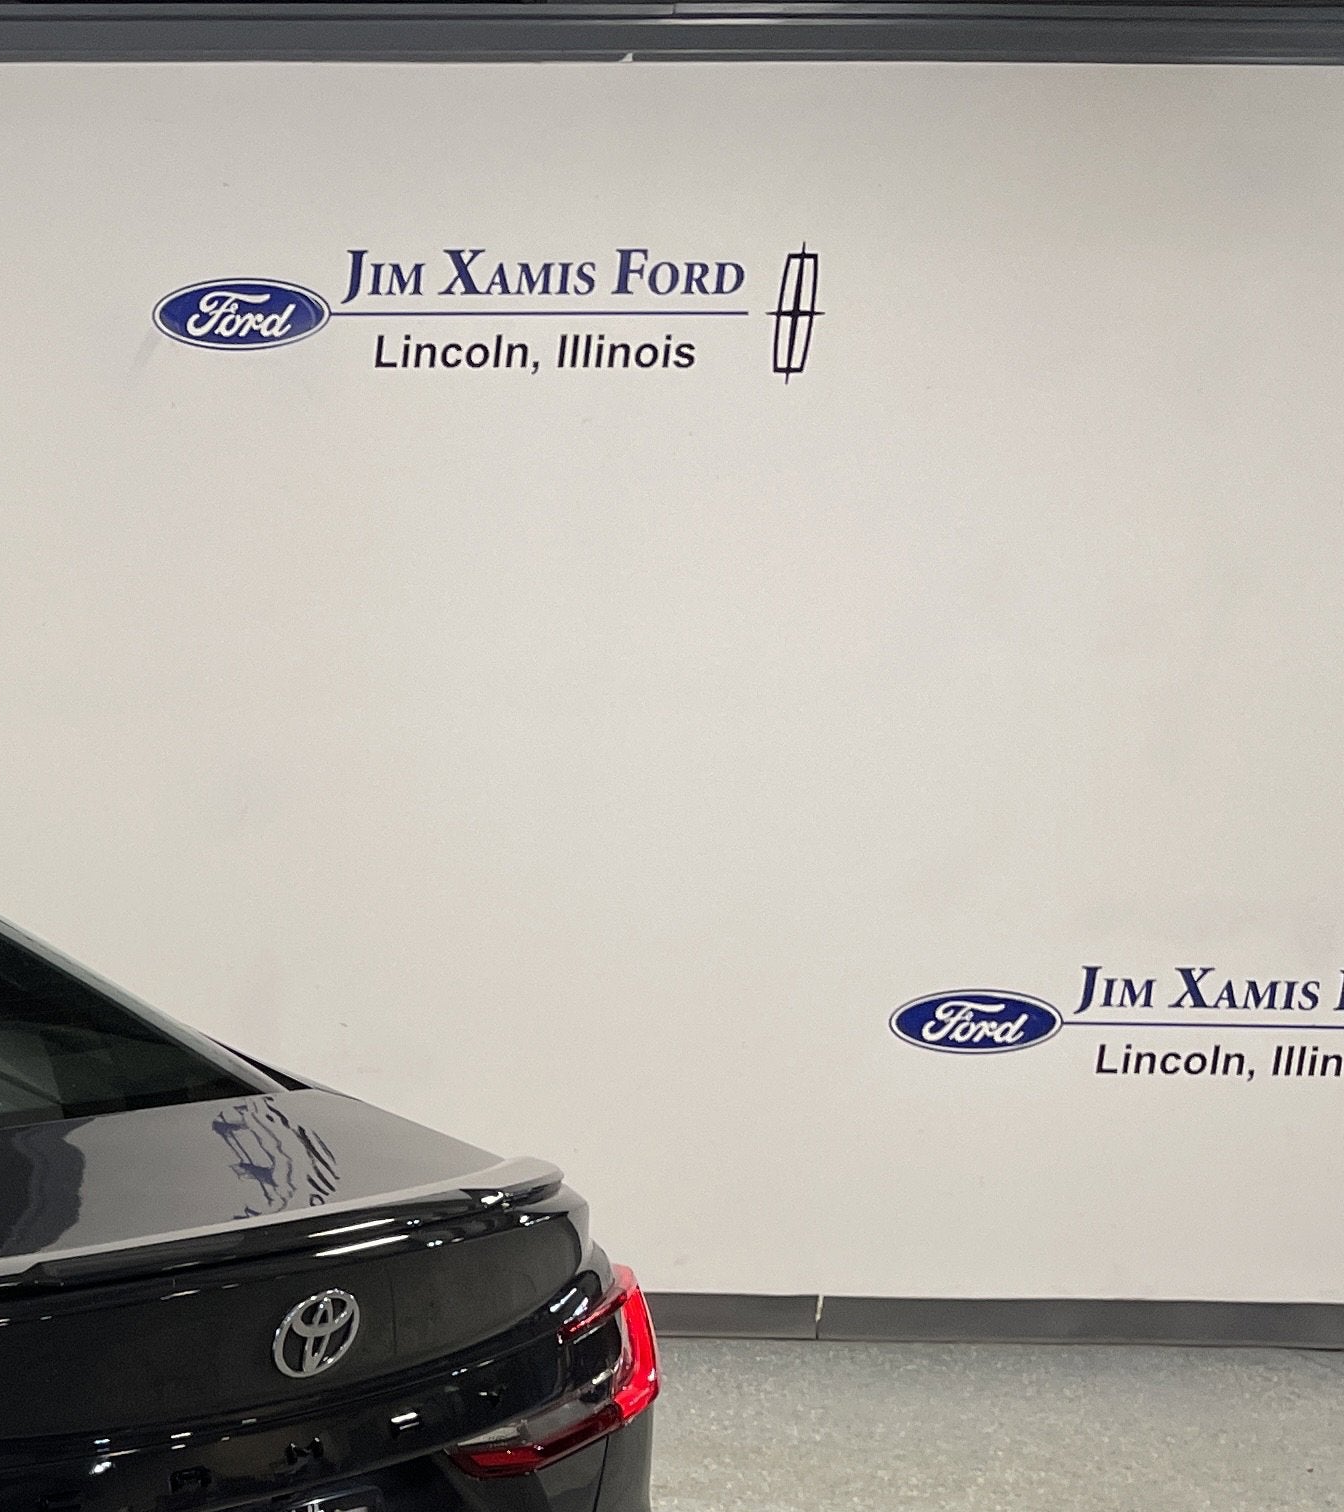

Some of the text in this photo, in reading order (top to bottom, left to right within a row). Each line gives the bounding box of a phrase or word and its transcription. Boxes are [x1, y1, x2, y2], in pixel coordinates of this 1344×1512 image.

[340, 248, 745, 304] JIM XAMIS FORD
[186, 291, 295, 338] Ford
[374, 334, 696, 374] Lincoln, Illinois
[1073, 965, 1157, 1014] JIM
[1167, 967, 1320, 1011] XAMIS
[920, 1000, 1029, 1045] Ford
[1095, 1043, 1256, 1082] Lincoln,
